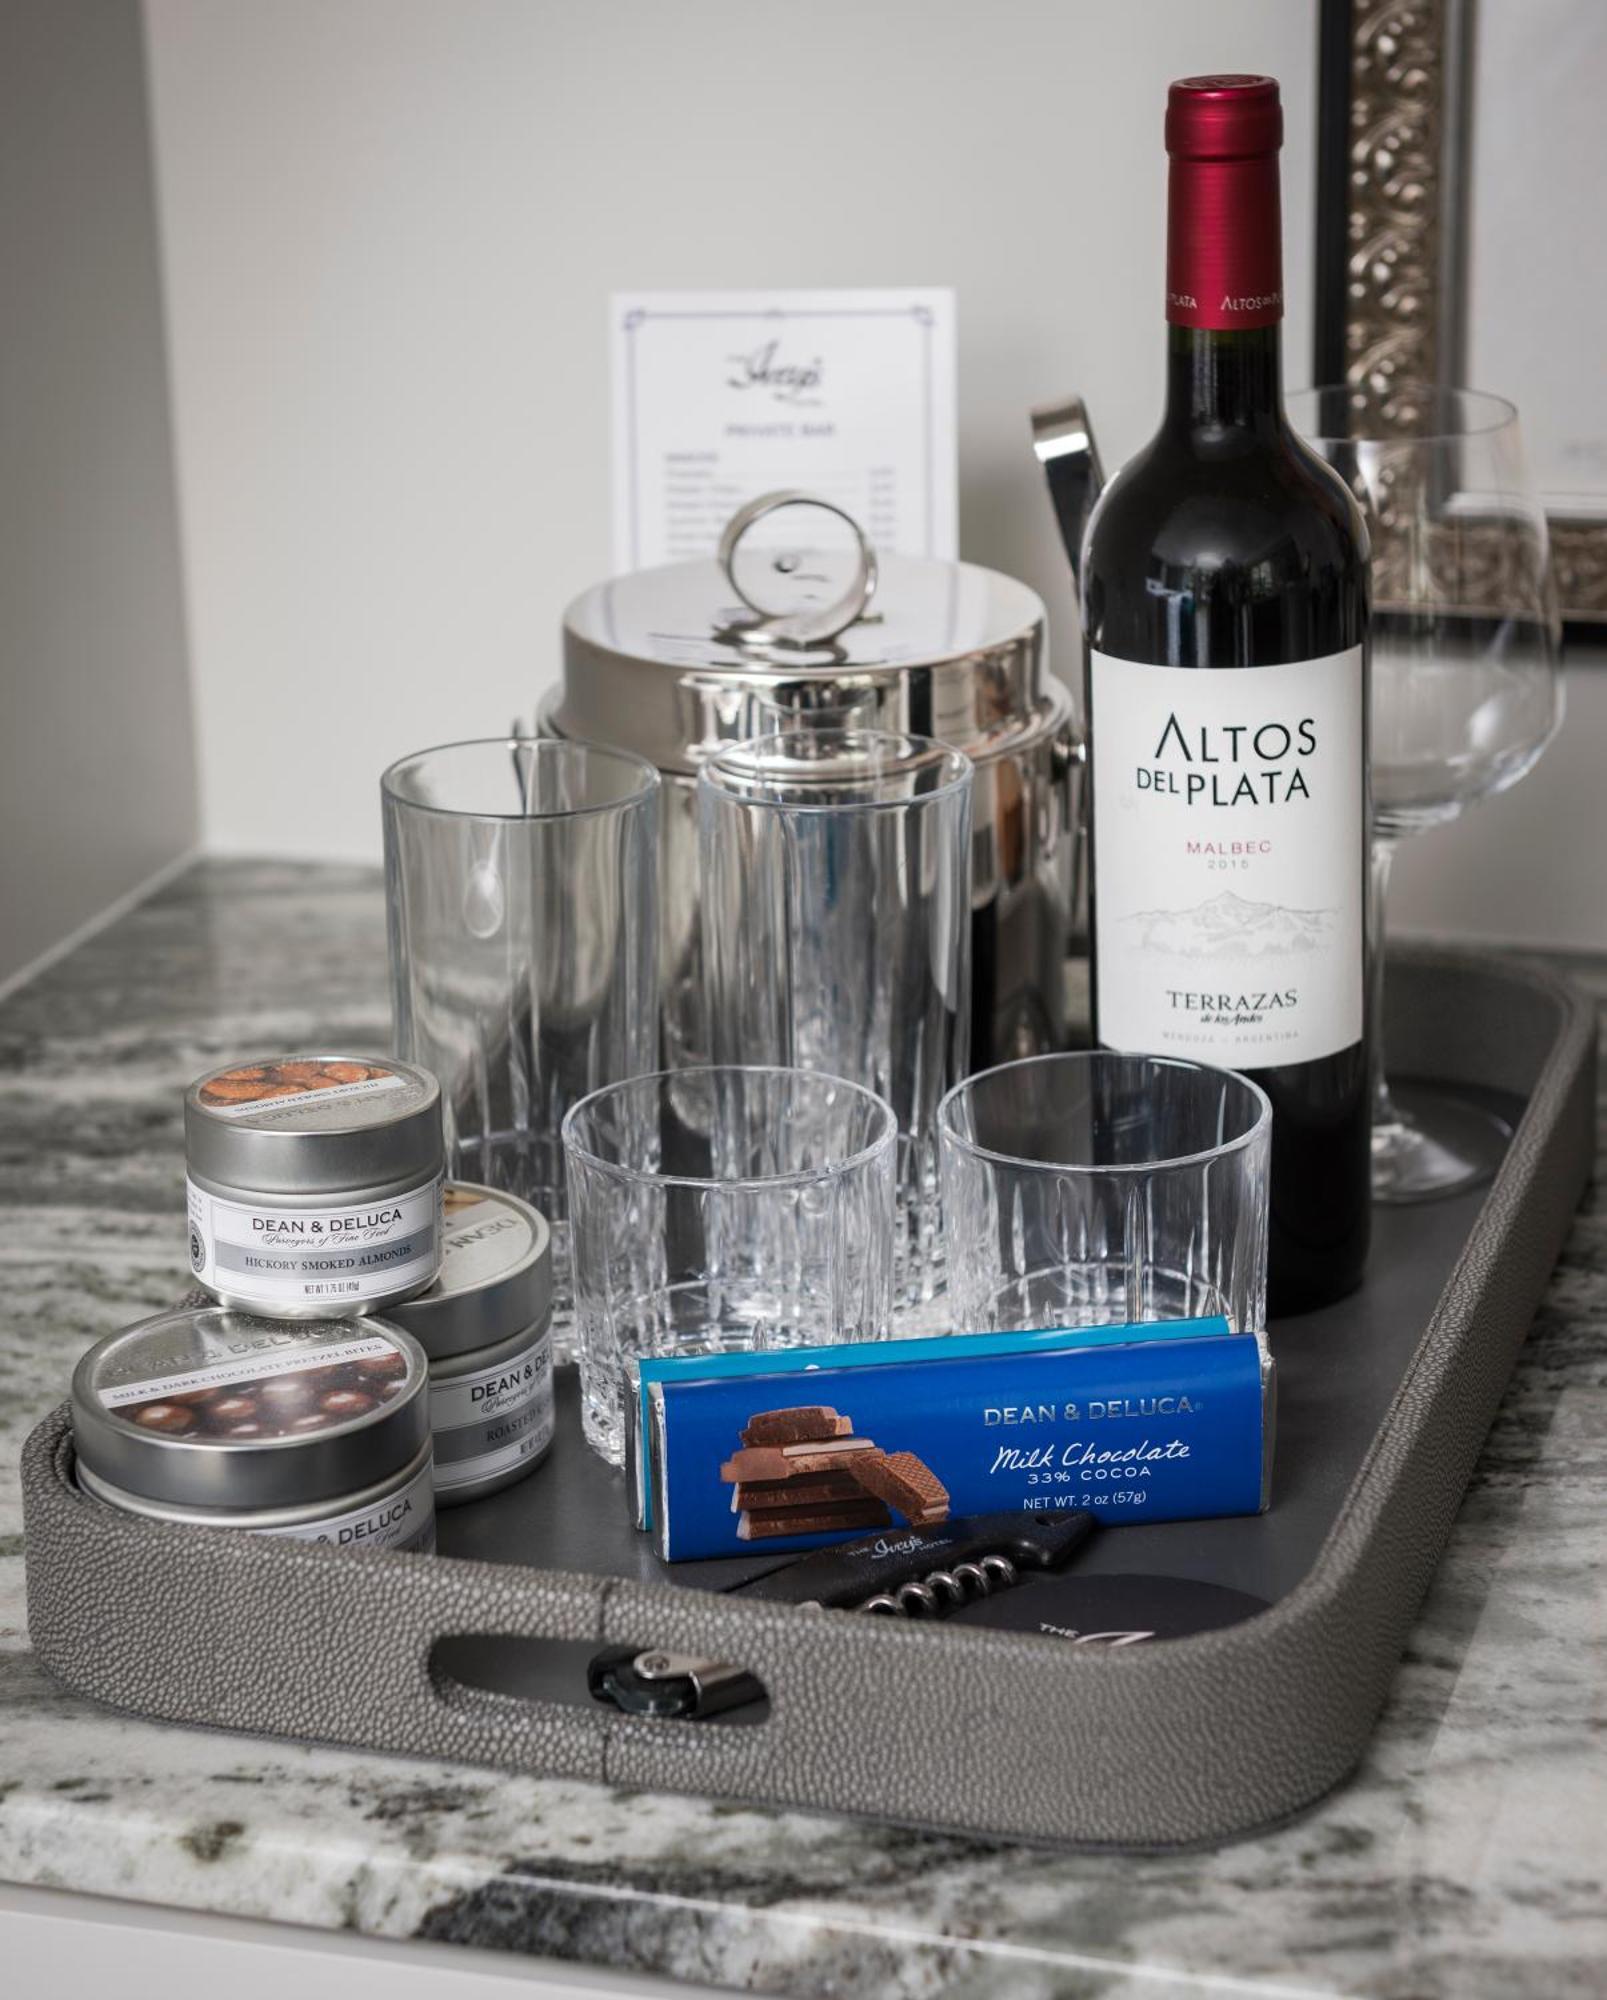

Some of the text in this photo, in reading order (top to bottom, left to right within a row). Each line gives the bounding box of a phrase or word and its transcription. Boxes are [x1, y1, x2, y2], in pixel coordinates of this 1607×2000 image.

[1220, 295, 1262, 311] ALTOS
[1155, 712, 1316, 762] ALTOS
[1137, 767, 1310, 806] DEL PLATA
[1186, 840, 1273, 855] MALBEC
[1165, 988, 1298, 1011] TERRAZAS
[252, 1208, 402, 1233] DEAN & DELUCA
[318, 1235, 329, 1247] of
[245, 1244, 413, 1271] HICKORY SMOKED ALMONDS
[471, 1371, 520, 1402] DEAN
[523, 1364, 534, 1380] &
[984, 1404, 1057, 1427] DEAN
[1063, 1402, 1081, 1421] &
[989, 1439, 1192, 1474] Milk Chocolate
[1027, 1465, 1152, 1485] 33% COCOA
[1023, 1490, 1147, 1510] NET WT. 2 oz (57g)
[339, 1499, 412, 1545] DELUCA
[1040, 1622, 1080, 1639] THE
